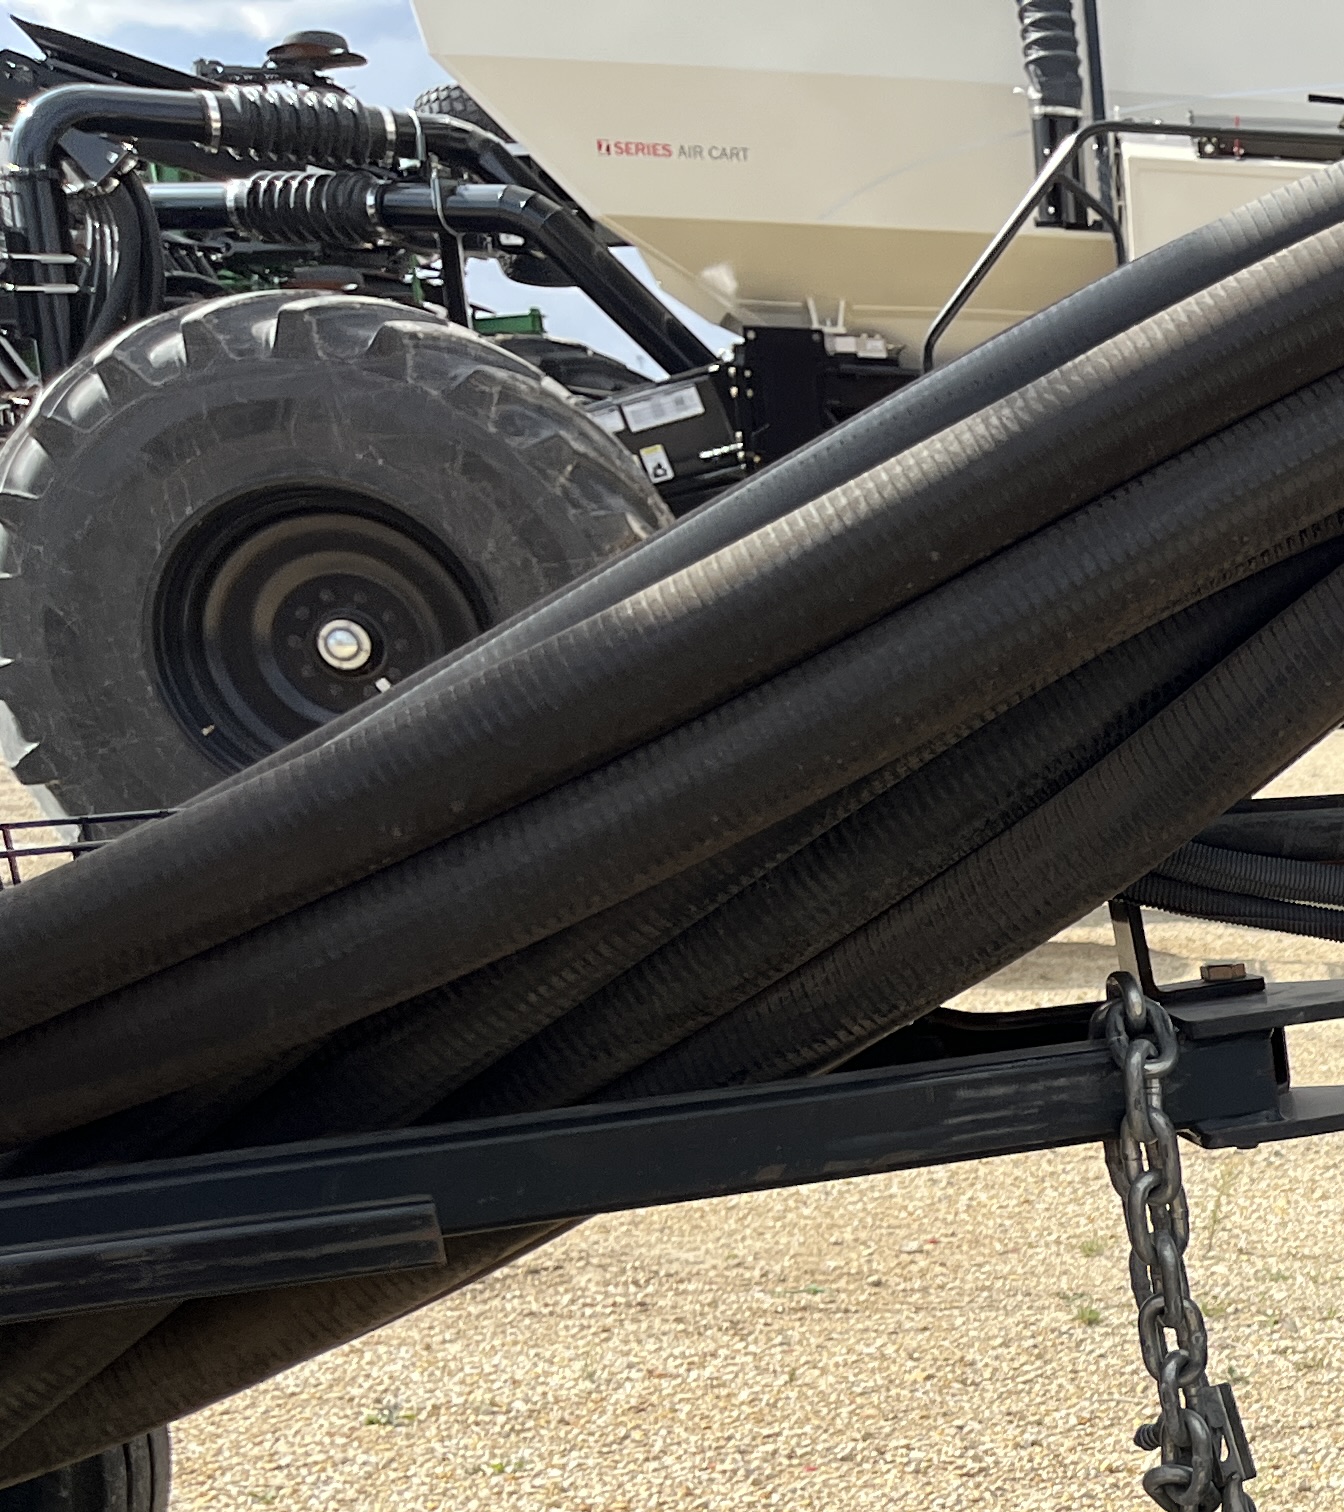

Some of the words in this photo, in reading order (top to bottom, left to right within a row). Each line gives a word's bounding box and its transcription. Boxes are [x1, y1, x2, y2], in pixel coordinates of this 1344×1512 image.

[614, 140, 673, 158] SERIES
[677, 144, 704, 160] AIR
[707, 145, 749, 162] CART
